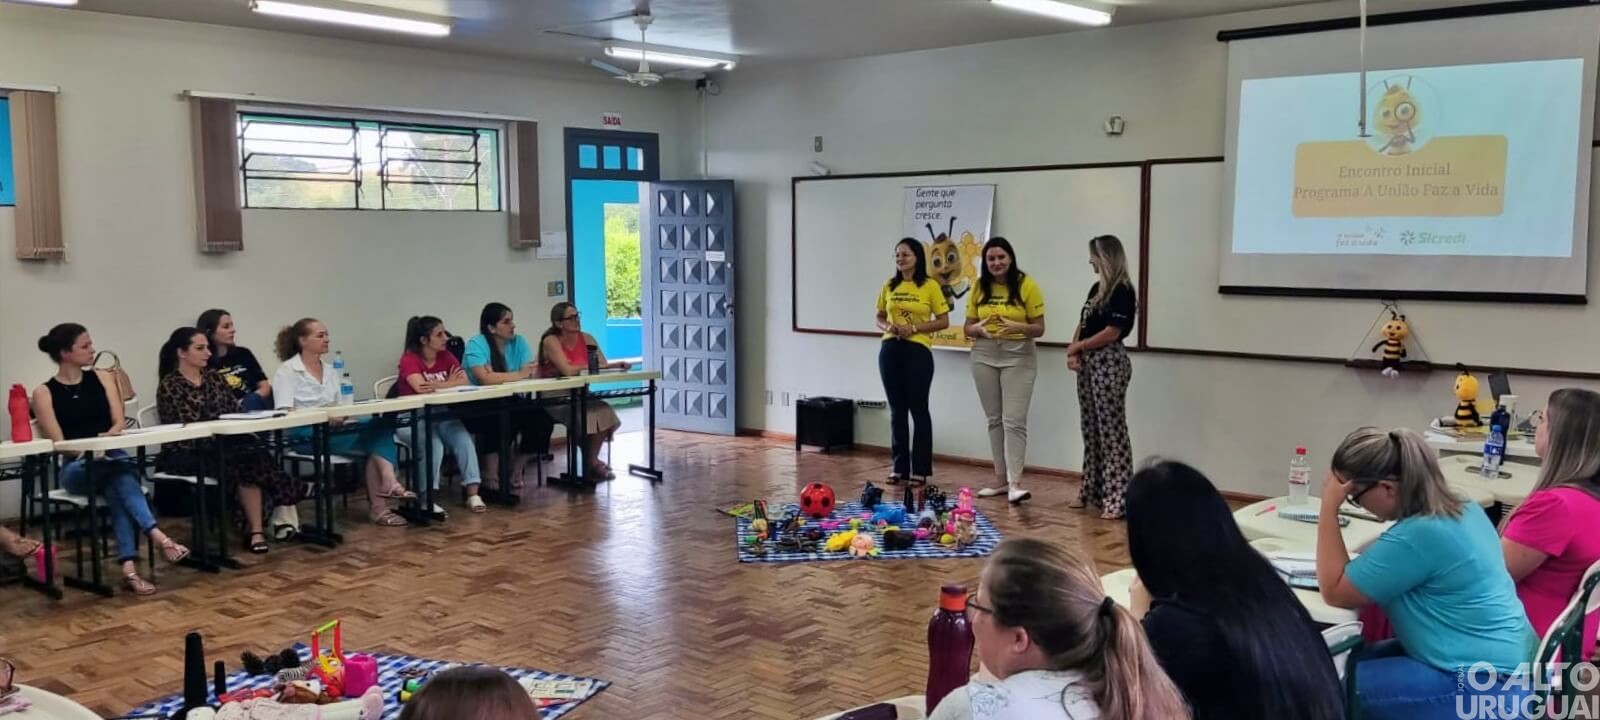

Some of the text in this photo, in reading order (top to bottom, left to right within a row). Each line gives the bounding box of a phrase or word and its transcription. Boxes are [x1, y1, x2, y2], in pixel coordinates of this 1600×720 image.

[1338, 163, 1451, 179] Encontro Inicial
[916, 187, 956, 199] Gente que
[1294, 186, 1360, 202] Programa
[1423, 183, 1448, 197] Faz
[1451, 187, 1461, 196] a
[1466, 183, 1499, 197] Vida
[915, 200, 952, 211] pergunta
[1418, 232, 1466, 244] Sicredi
